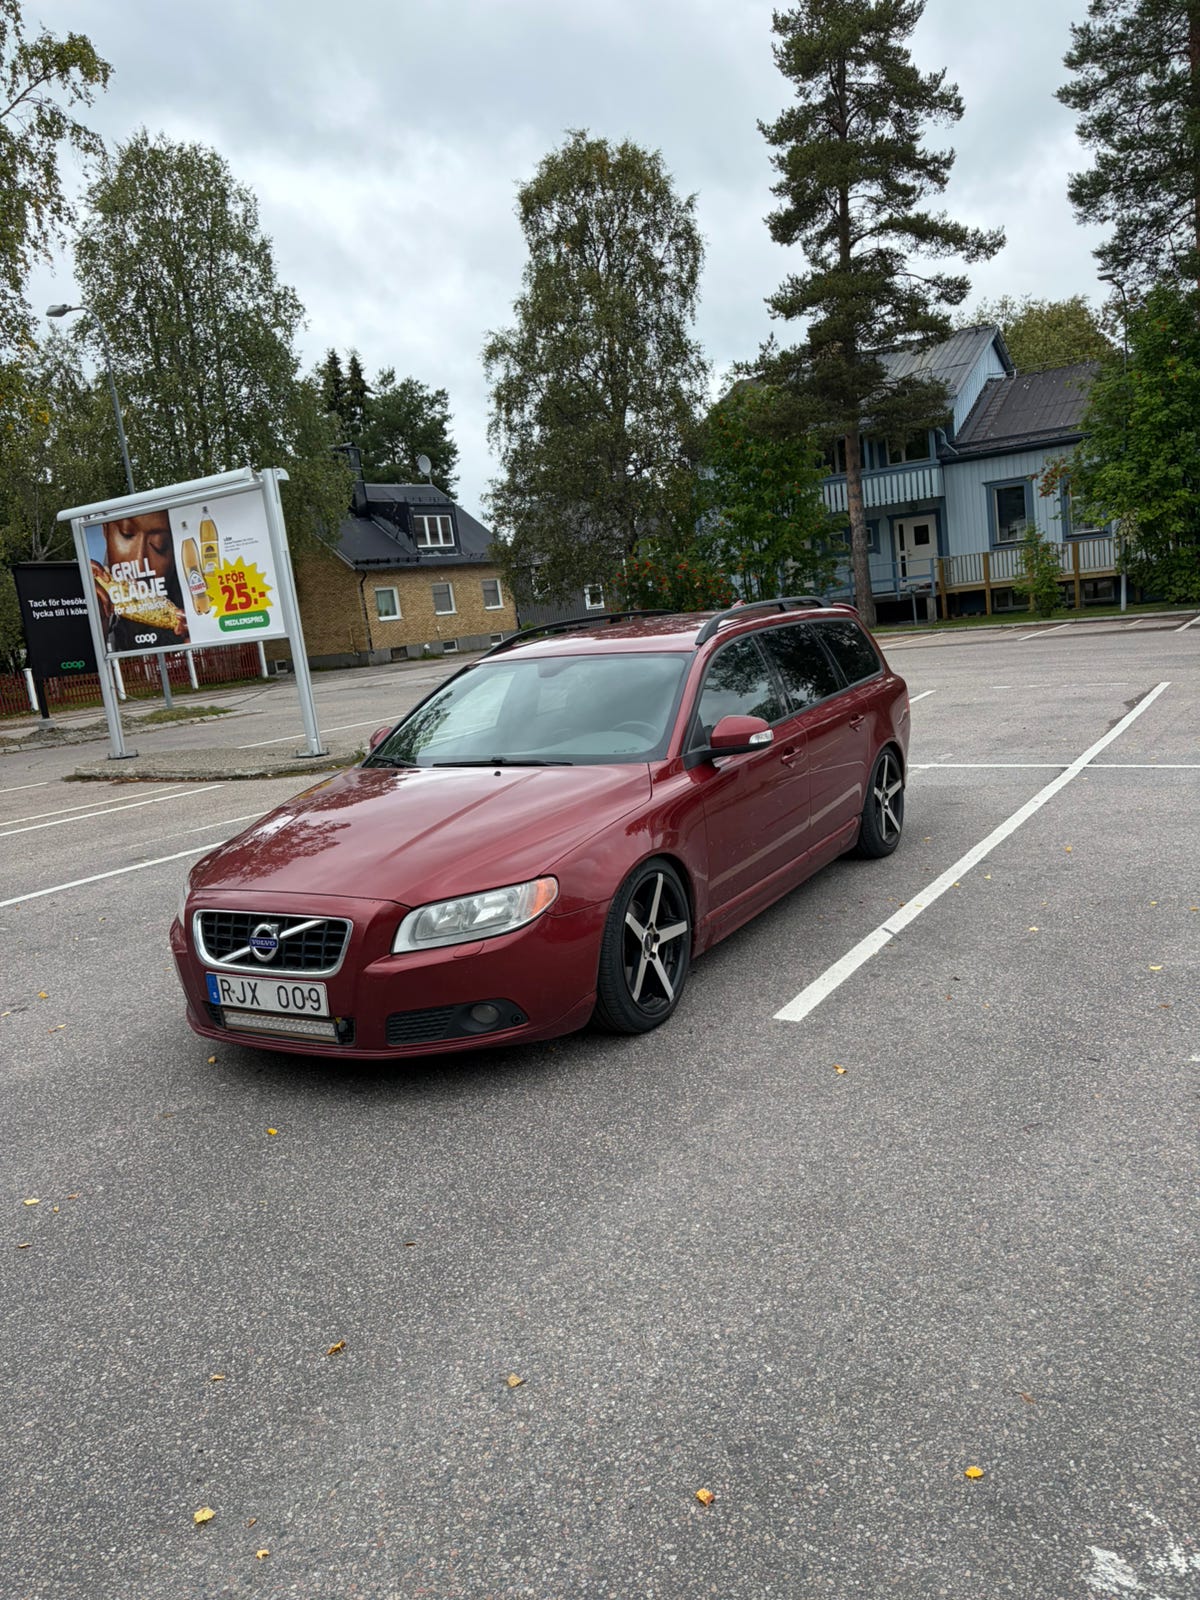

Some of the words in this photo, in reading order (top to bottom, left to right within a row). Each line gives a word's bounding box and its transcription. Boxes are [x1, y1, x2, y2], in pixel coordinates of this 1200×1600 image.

[112, 558, 156, 582] GRILL
[218, 575, 224, 585] 2
[225, 570, 245, 584] FÖR
[108, 576, 168, 604] GLÄDJE
[28, 599, 48, 608] Tack
[49, 598, 60, 607] för
[221, 582, 266, 612] 25:-
[32, 610, 54, 620] lycka
[55, 608, 65, 617] till
[66, 608, 69, 616] i
[135, 633, 157, 644] coop
[61, 660, 85, 669] coop
[251, 939, 276, 947] VOLVO
[220, 979, 260, 1006] RJX
[277, 985, 321, 1012] 009
